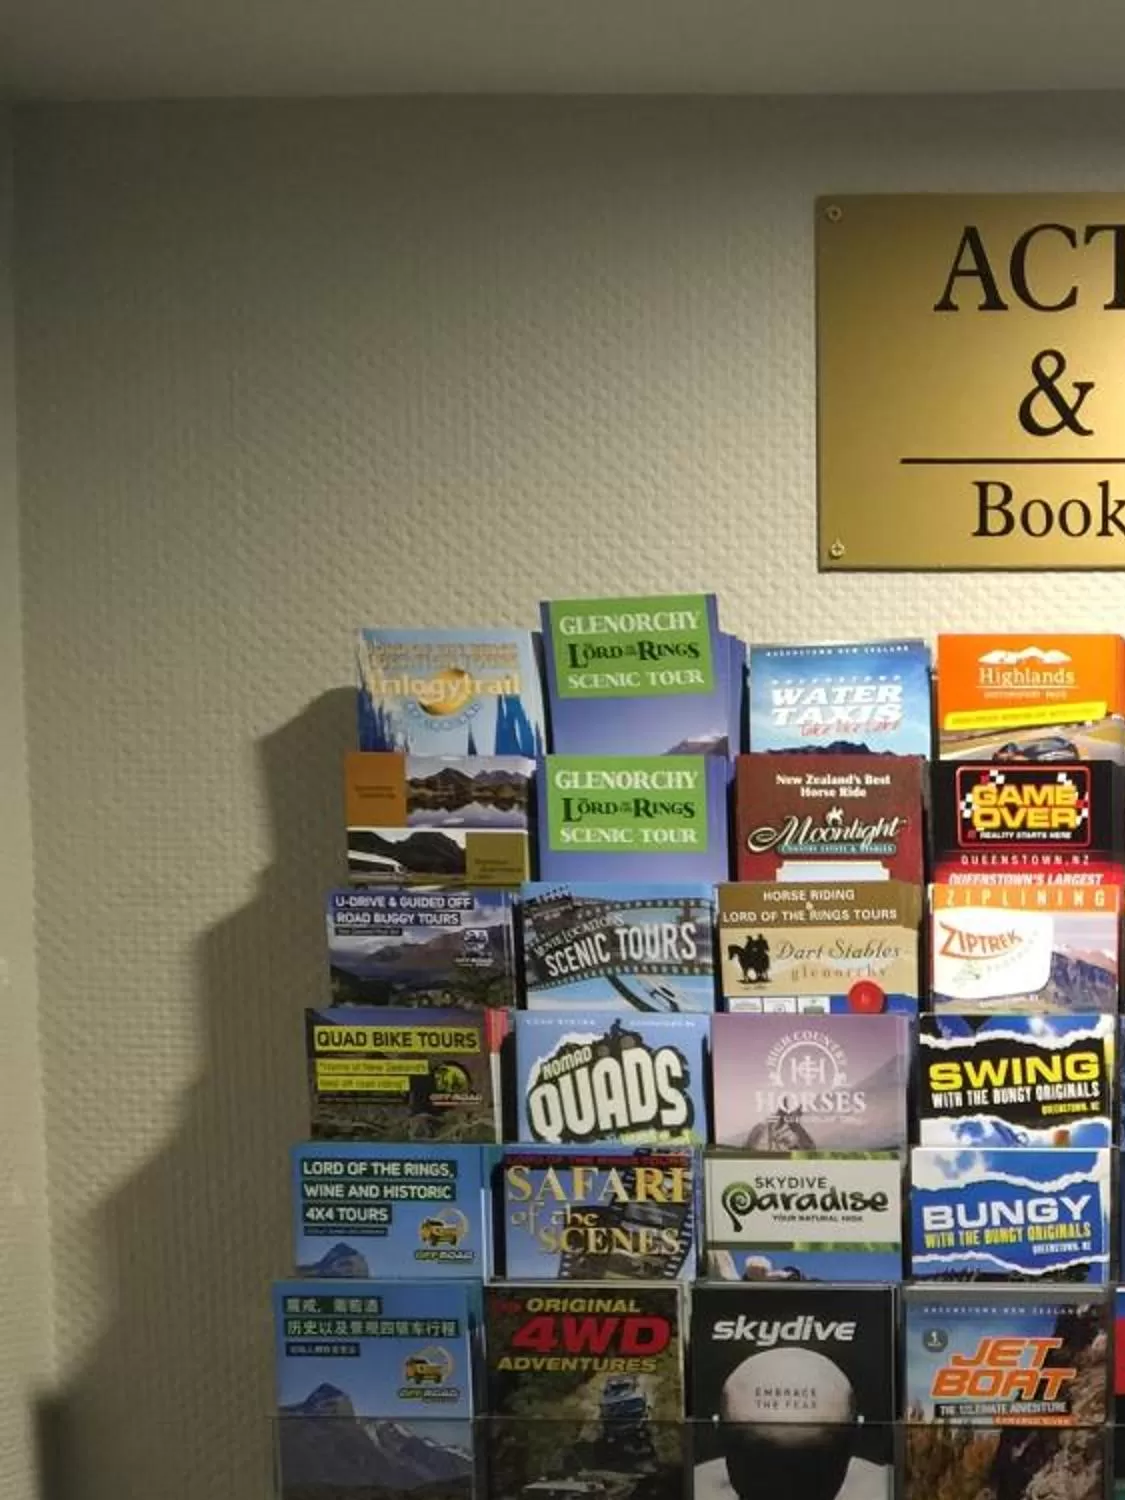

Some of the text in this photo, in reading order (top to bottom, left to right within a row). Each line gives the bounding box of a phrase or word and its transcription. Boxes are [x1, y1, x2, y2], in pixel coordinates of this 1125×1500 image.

[1018, 348, 1094, 437] &
[639, 640, 700, 661] RINGS
[980, 668, 1074, 686] Highlands
[772, 685, 902, 705] WATER
[776, 774, 891, 786] New Zealand's Best
[801, 786, 867, 798] Horse Ride
[973, 784, 1078, 806] GAME
[973, 808, 1078, 829] OVER
[748, 816, 906, 854] Moonlight
[764, 889, 855, 902] HORSE RIDING
[337, 912, 459, 925] ROAD BUGGY TOURS
[723, 909, 897, 923] LORD OF THE RINGS TOURS
[545, 923, 697, 977] SCENIC TOURS
[318, 1032, 477, 1048] QUAD BIKE TOURS
[930, 1052, 1099, 1091] SWING
[530, 1049, 688, 1142] QUADS
[304, 1162, 340, 1176] LORD
[344, 1162, 369, 1176] OF
[372, 1162, 401, 1176] THE
[304, 1185, 451, 1199] WINE AND HISTORIC
[507, 1166, 685, 1203] SAFARI
[755, 1177, 826, 1189] SKYDIVE
[923, 1195, 1091, 1230] BUNGY
[540, 1227, 680, 1256] SCENES
[527, 1298, 640, 1313] ORIGINAL
[512, 1317, 672, 1354] 4WD
[712, 1315, 857, 1346] skydive
[950, 1337, 1063, 1367] JET
[499, 1357, 657, 1372] ADVENTURES
[932, 1368, 1078, 1401] BOAT
